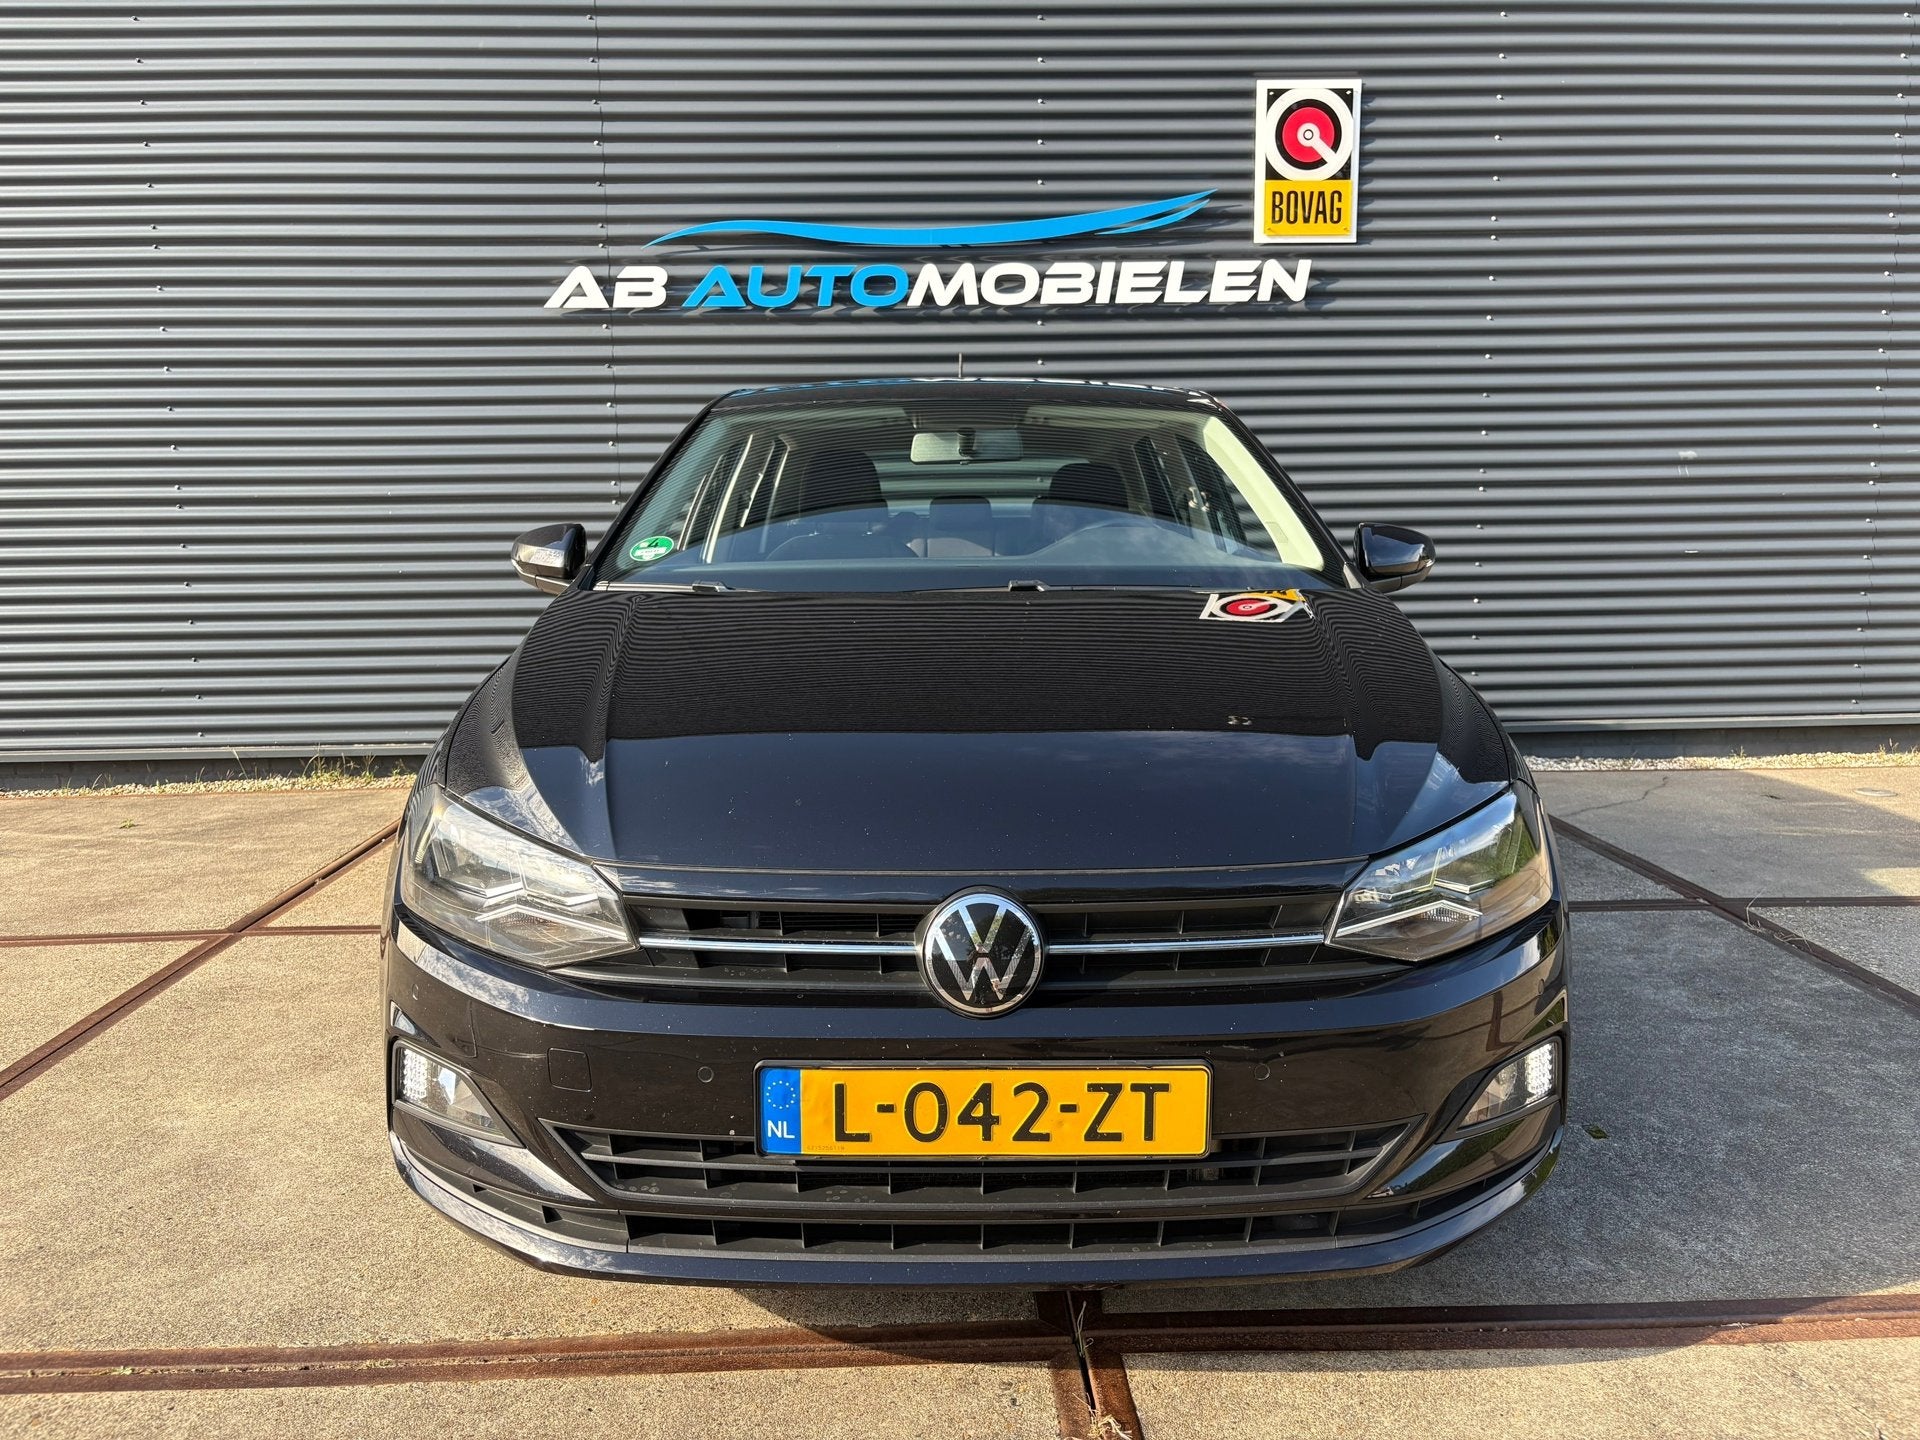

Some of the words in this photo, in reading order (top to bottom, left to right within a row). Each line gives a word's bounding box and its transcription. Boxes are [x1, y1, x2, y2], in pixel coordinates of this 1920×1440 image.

[1271, 190, 1343, 224] BOVAG
[544, 265, 667, 308] AB
[682, 259, 1312, 308] AUTOMOBIELEN
[647, 538, 659, 548] 4
[834, 1082, 1170, 1142] L-042-ZT
[767, 1120, 795, 1139] NL
